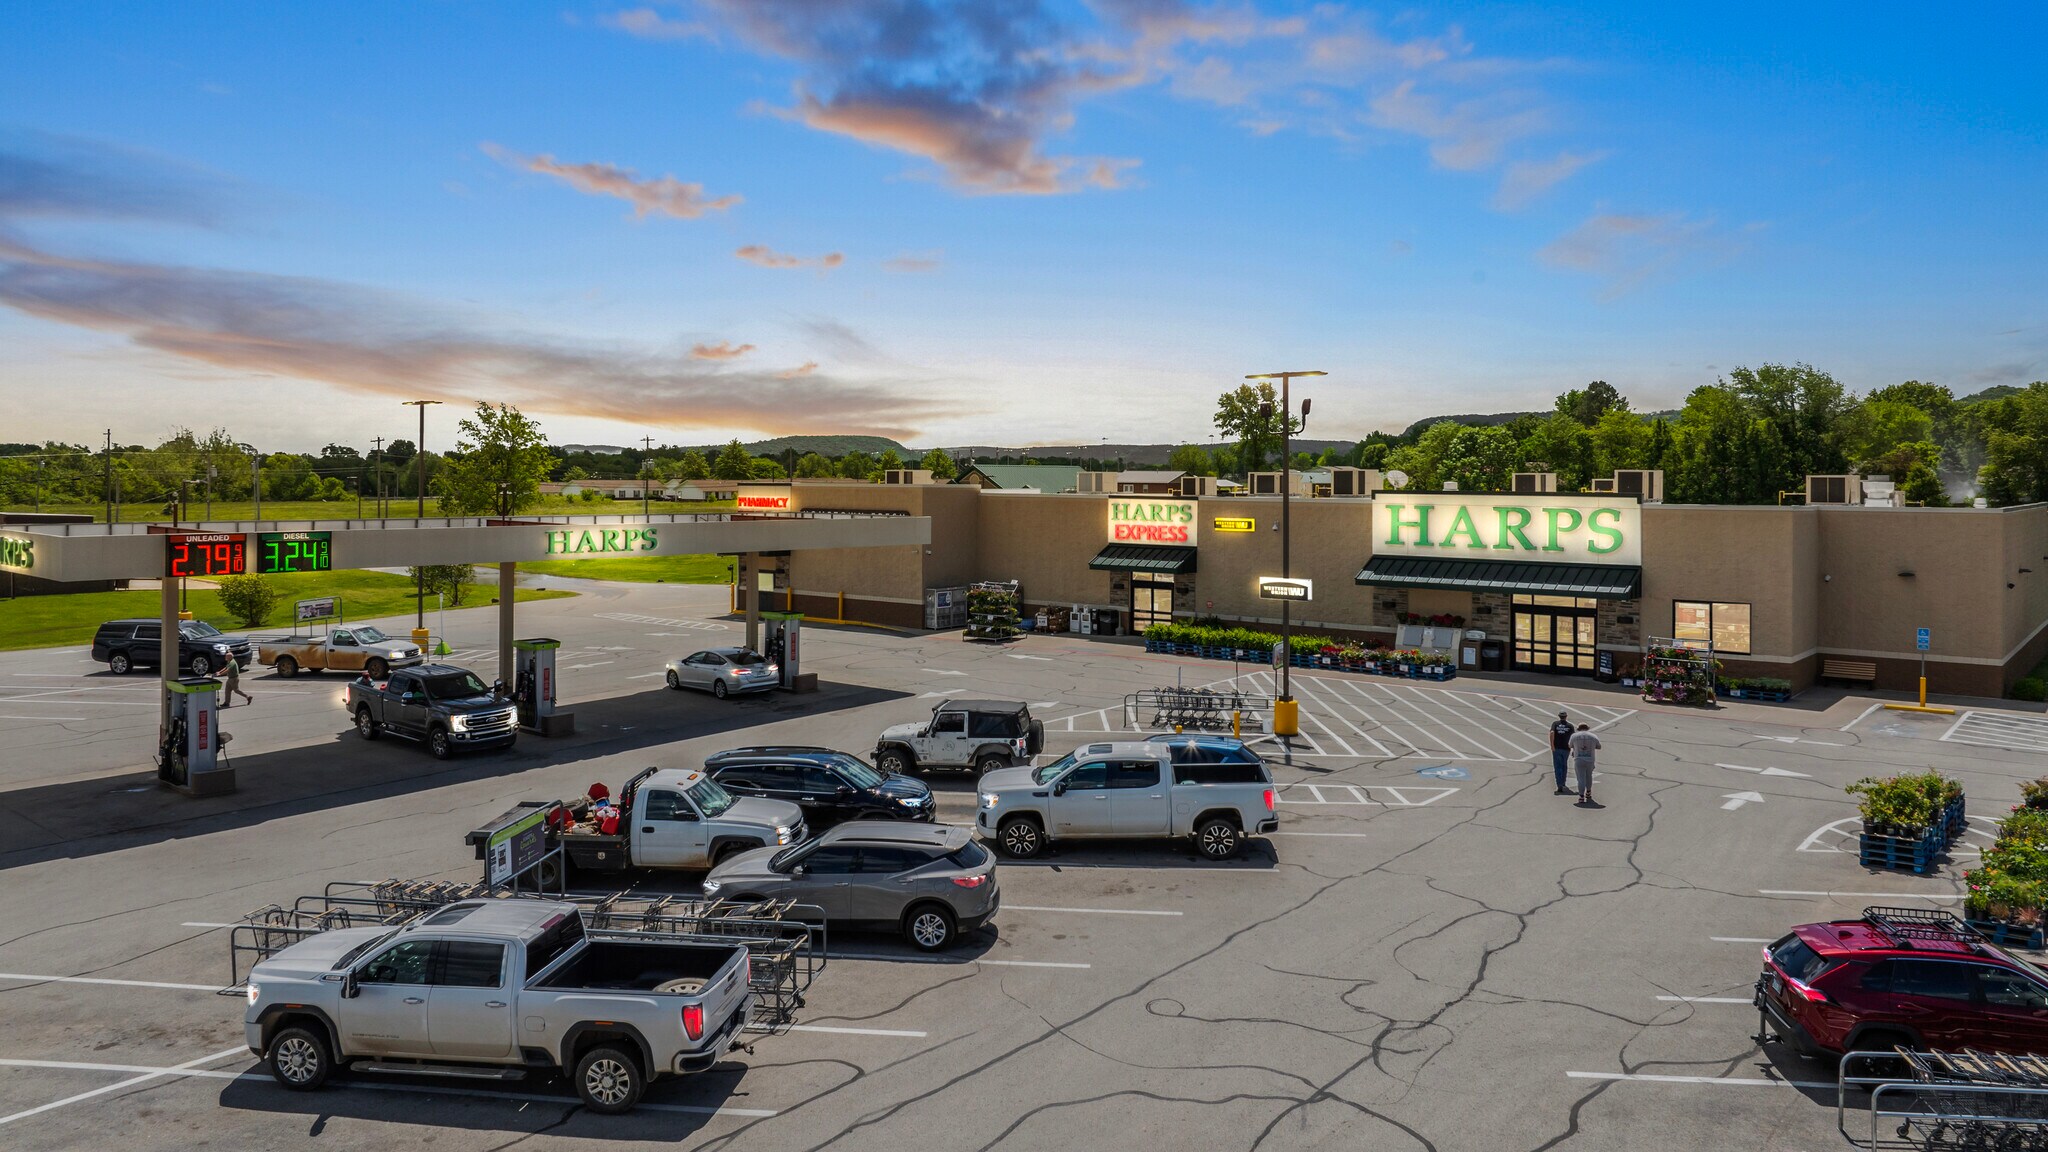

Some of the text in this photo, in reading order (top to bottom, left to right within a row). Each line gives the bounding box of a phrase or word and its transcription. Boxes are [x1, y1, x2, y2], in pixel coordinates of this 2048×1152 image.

[738, 496, 789, 508] PHARMACY
[1111, 503, 1193, 523] HARPS
[186, 534, 230, 543] UNLEADED
[283, 532, 310, 540] DIESEL
[544, 527, 658, 555] HARPS
[1114, 524, 1189, 543] EXPRESS
[1384, 504, 1624, 555] HARPS
[0, 536, 34, 568] RPS
[172, 543, 231, 577] 2.79
[265, 541, 317, 572] 3.24
